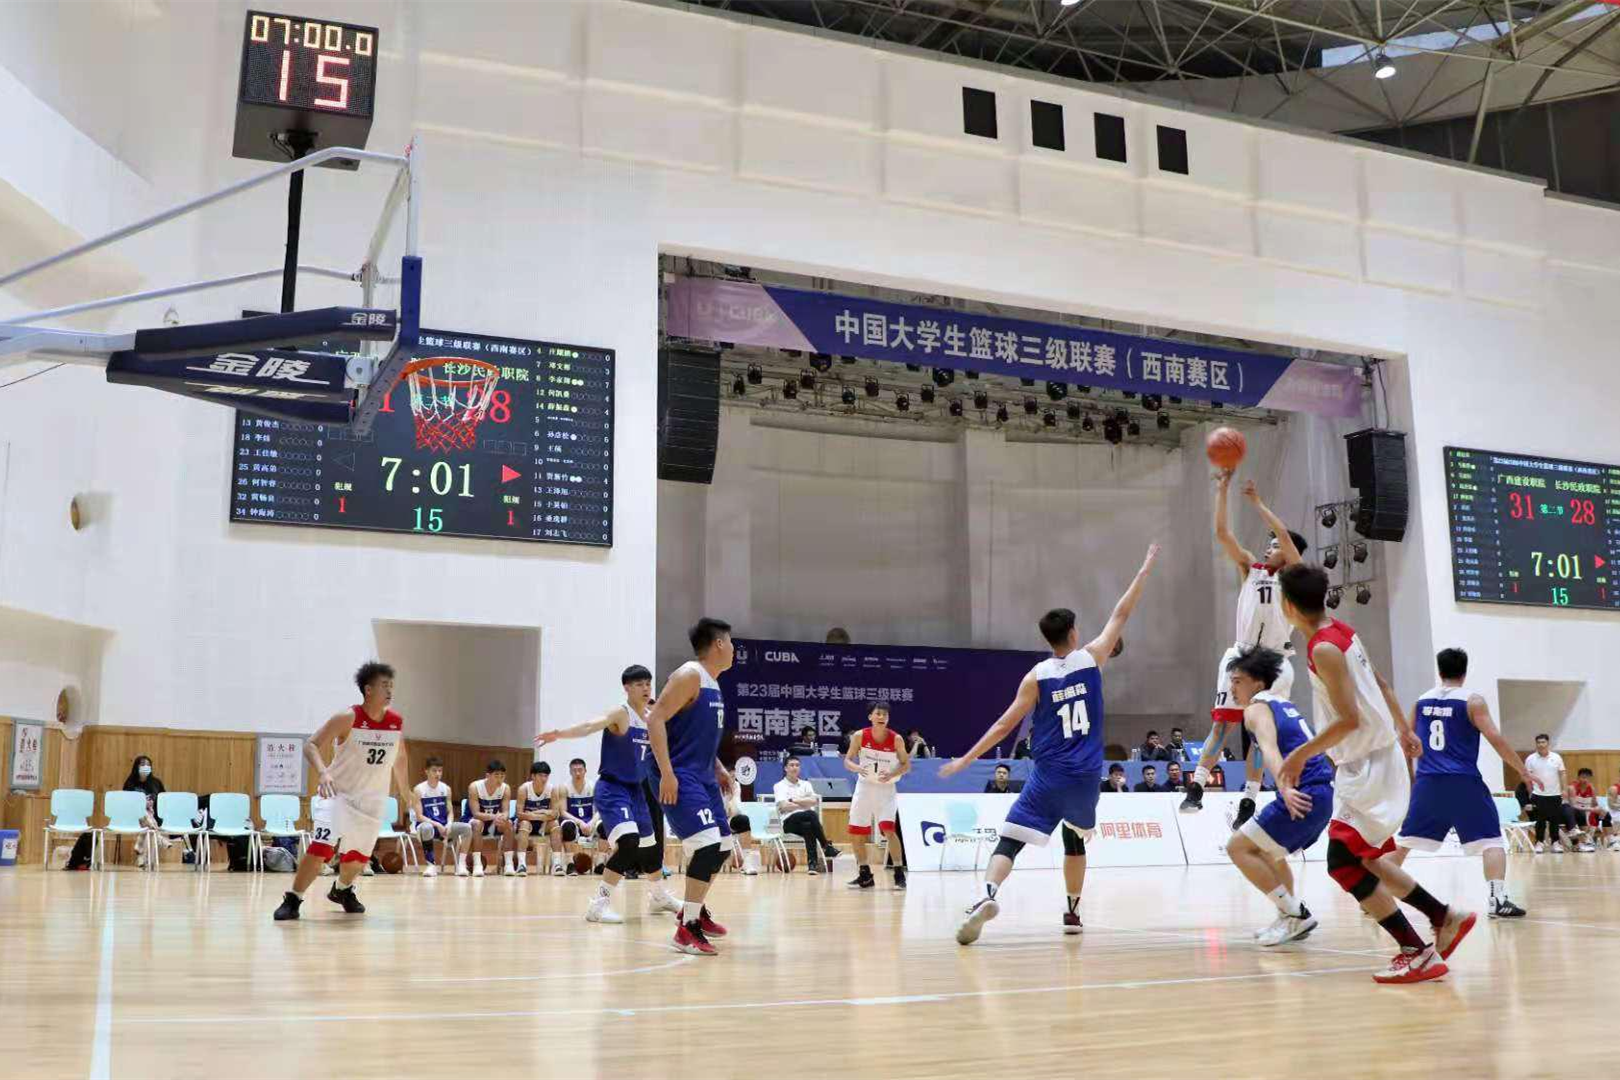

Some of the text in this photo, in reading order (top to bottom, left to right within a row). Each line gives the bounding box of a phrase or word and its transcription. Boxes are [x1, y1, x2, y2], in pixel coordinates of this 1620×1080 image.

[251, 15, 373, 56] 07:00.0
[278, 50, 350, 109] 15
[350, 313, 386, 326] 金陵
[208, 352, 313, 381] 金陵
[381, 456, 475, 498] 7:01
[337, 496, 347, 513] 1
[1509, 492, 1534, 520] 31
[1569, 499, 1596, 525] 28
[413, 507, 444, 532] 15
[506, 510, 515, 525] 1
[1531, 551, 1583, 580] 7:01
[1257, 586, 1272, 604] 17
[1551, 587, 1569, 606] 15
[765, 651, 800, 663] CUBA
[736, 707, 843, 738] 西南赛区
[1057, 700, 1090, 739] 14
[1429, 719, 1445, 751] 8
[366, 748, 386, 765] 32
[873, 762, 879, 774] 1
[620, 807, 630, 819] 7
[697, 808, 715, 825] 12
[315, 827, 332, 841] 32
[1100, 822, 1164, 840] 阿里体育
